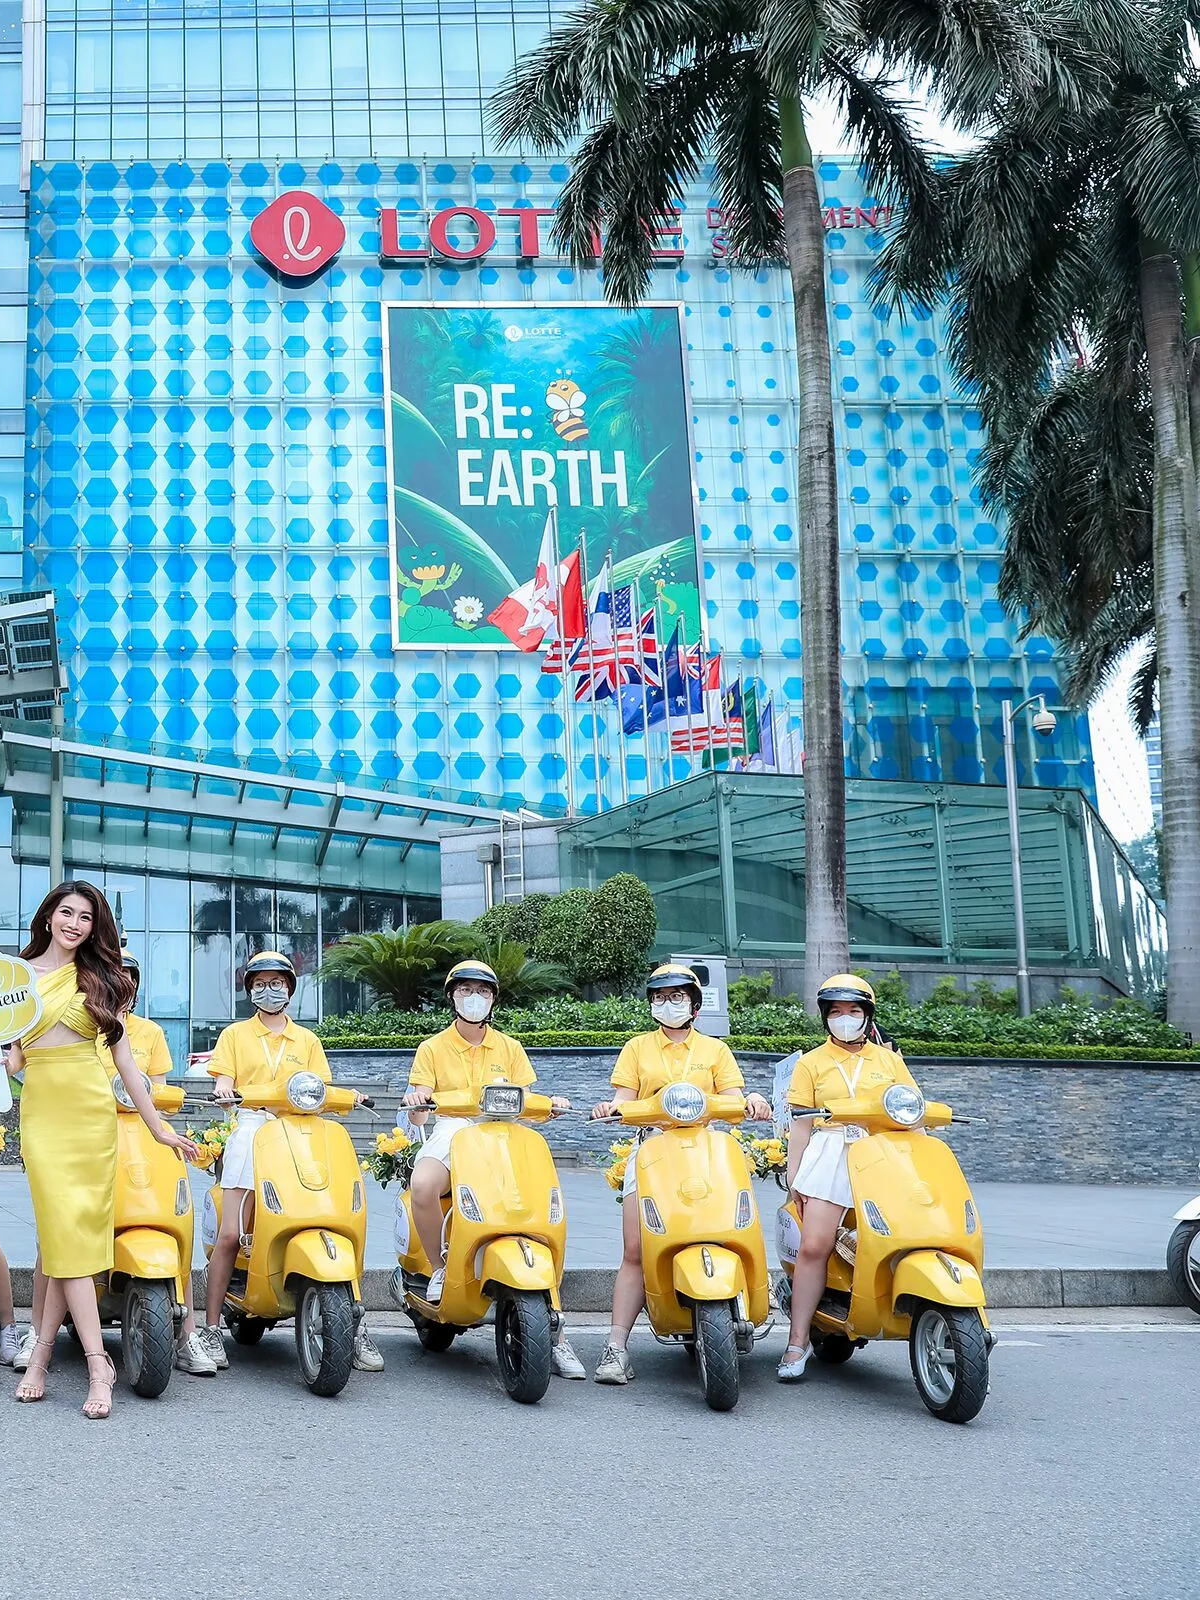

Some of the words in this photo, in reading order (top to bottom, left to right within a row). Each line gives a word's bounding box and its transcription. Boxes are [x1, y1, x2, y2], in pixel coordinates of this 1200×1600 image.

[380, 206, 685, 258] LOTE
[524, 327, 562, 335] LOTTE
[453, 383, 534, 440] RE:
[457, 449, 630, 507] EARTH
